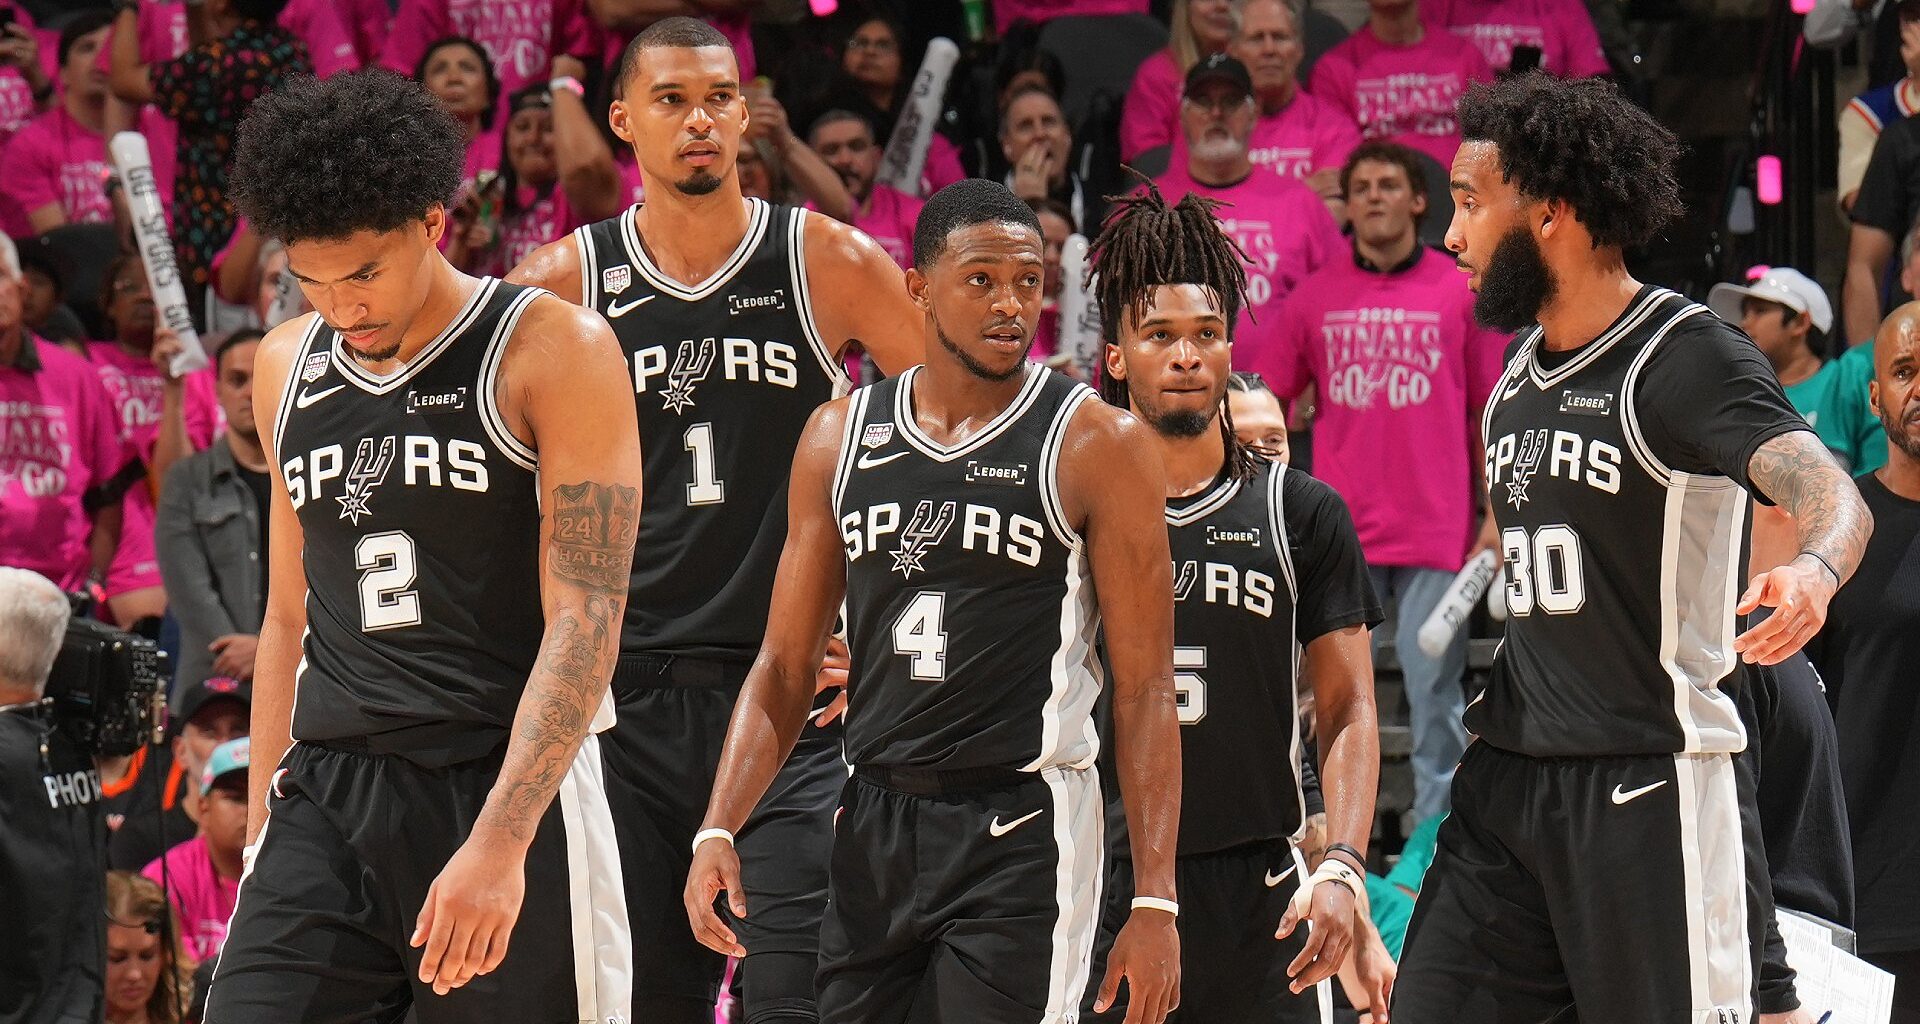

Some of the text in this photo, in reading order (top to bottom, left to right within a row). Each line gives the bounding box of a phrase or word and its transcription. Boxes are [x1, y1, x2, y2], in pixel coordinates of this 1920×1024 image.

[735, 296, 778, 309] LEDGER
[1358, 307, 1406, 324] 2026
[625, 338, 798, 416] PURS
[1321, 323, 1442, 373] FINALS
[414, 393, 459, 407] LEDGER
[1328, 363, 1431, 411] GO GO
[1567, 396, 1606, 409] LEDGER
[284, 435, 489, 526] SPURS
[683, 421, 726, 507] 1
[973, 466, 1019, 480] LEDGER
[1485, 428, 1622, 511] SPURS
[560, 516, 592, 540] 24
[841, 500, 1044, 580] SPURS
[1213, 531, 1254, 543] LEDGER
[354, 530, 422, 632] 2
[1502, 523, 1586, 618] 30
[892, 591, 948, 682] 4
[1173, 646, 1208, 726] 5
